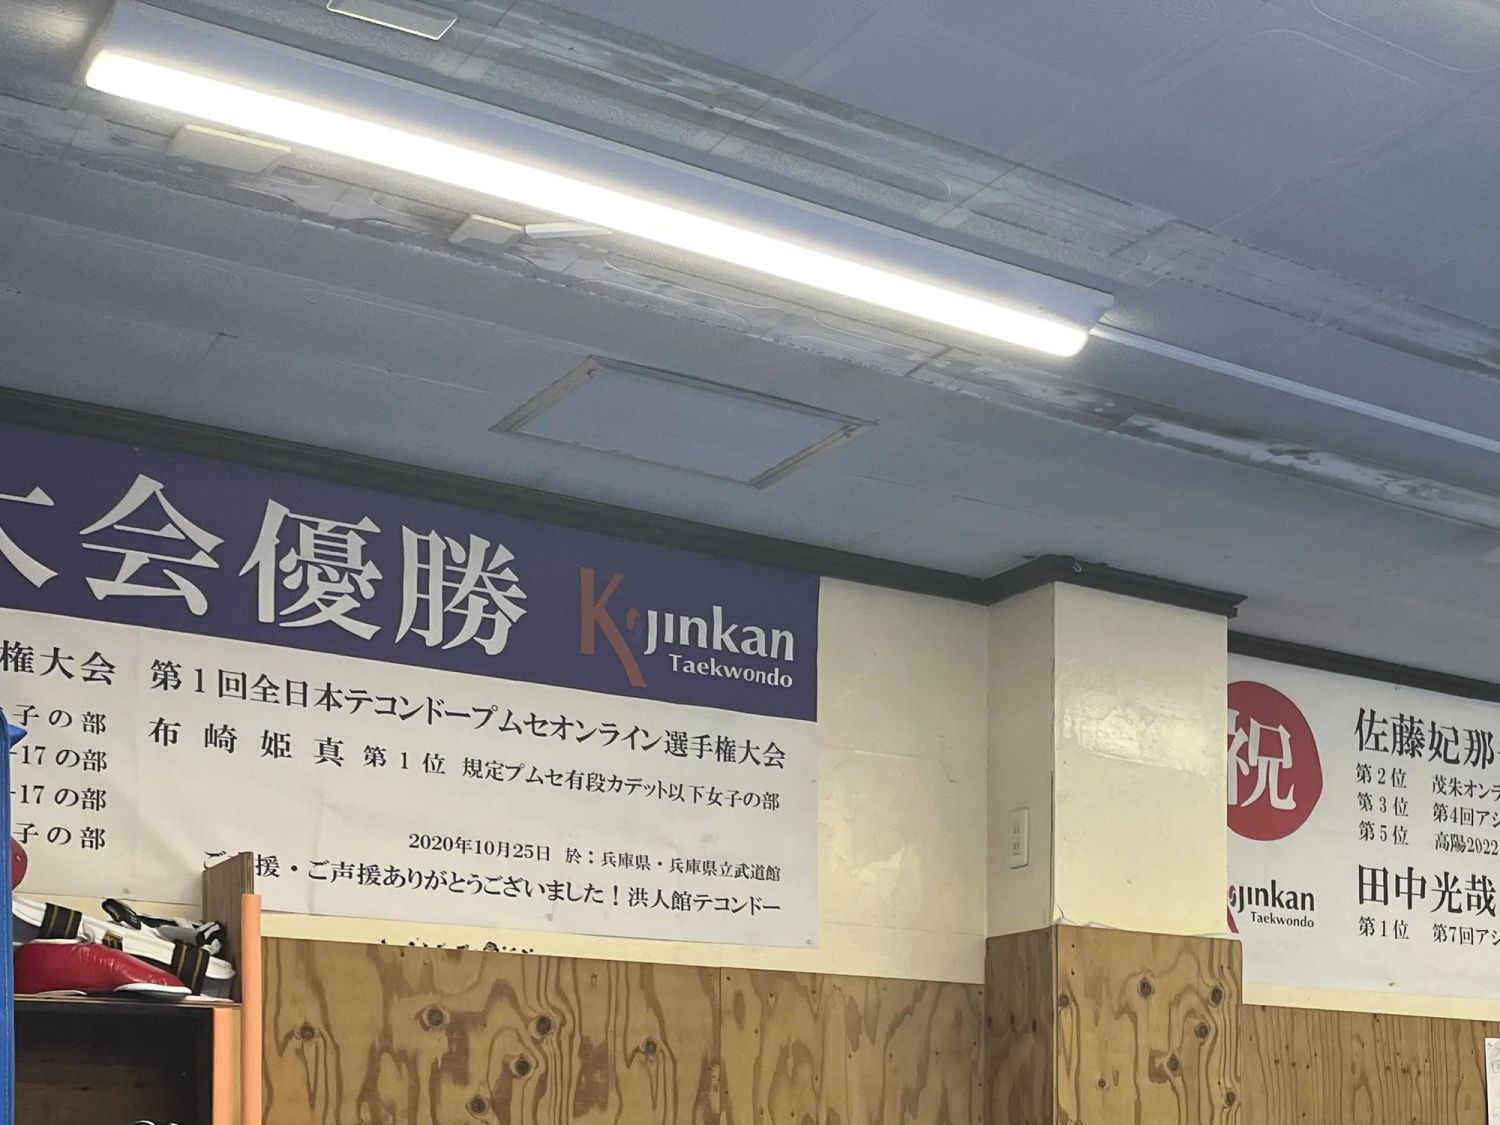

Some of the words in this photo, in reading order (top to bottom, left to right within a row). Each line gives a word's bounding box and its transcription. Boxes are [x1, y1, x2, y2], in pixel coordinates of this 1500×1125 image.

[669, 653, 793, 688] Taekwondo
[409, 833, 551, 862] 2020年10月25日
[1358, 864, 1496, 917] 田中光哉
[1250, 911, 1315, 928] Taekwondo
